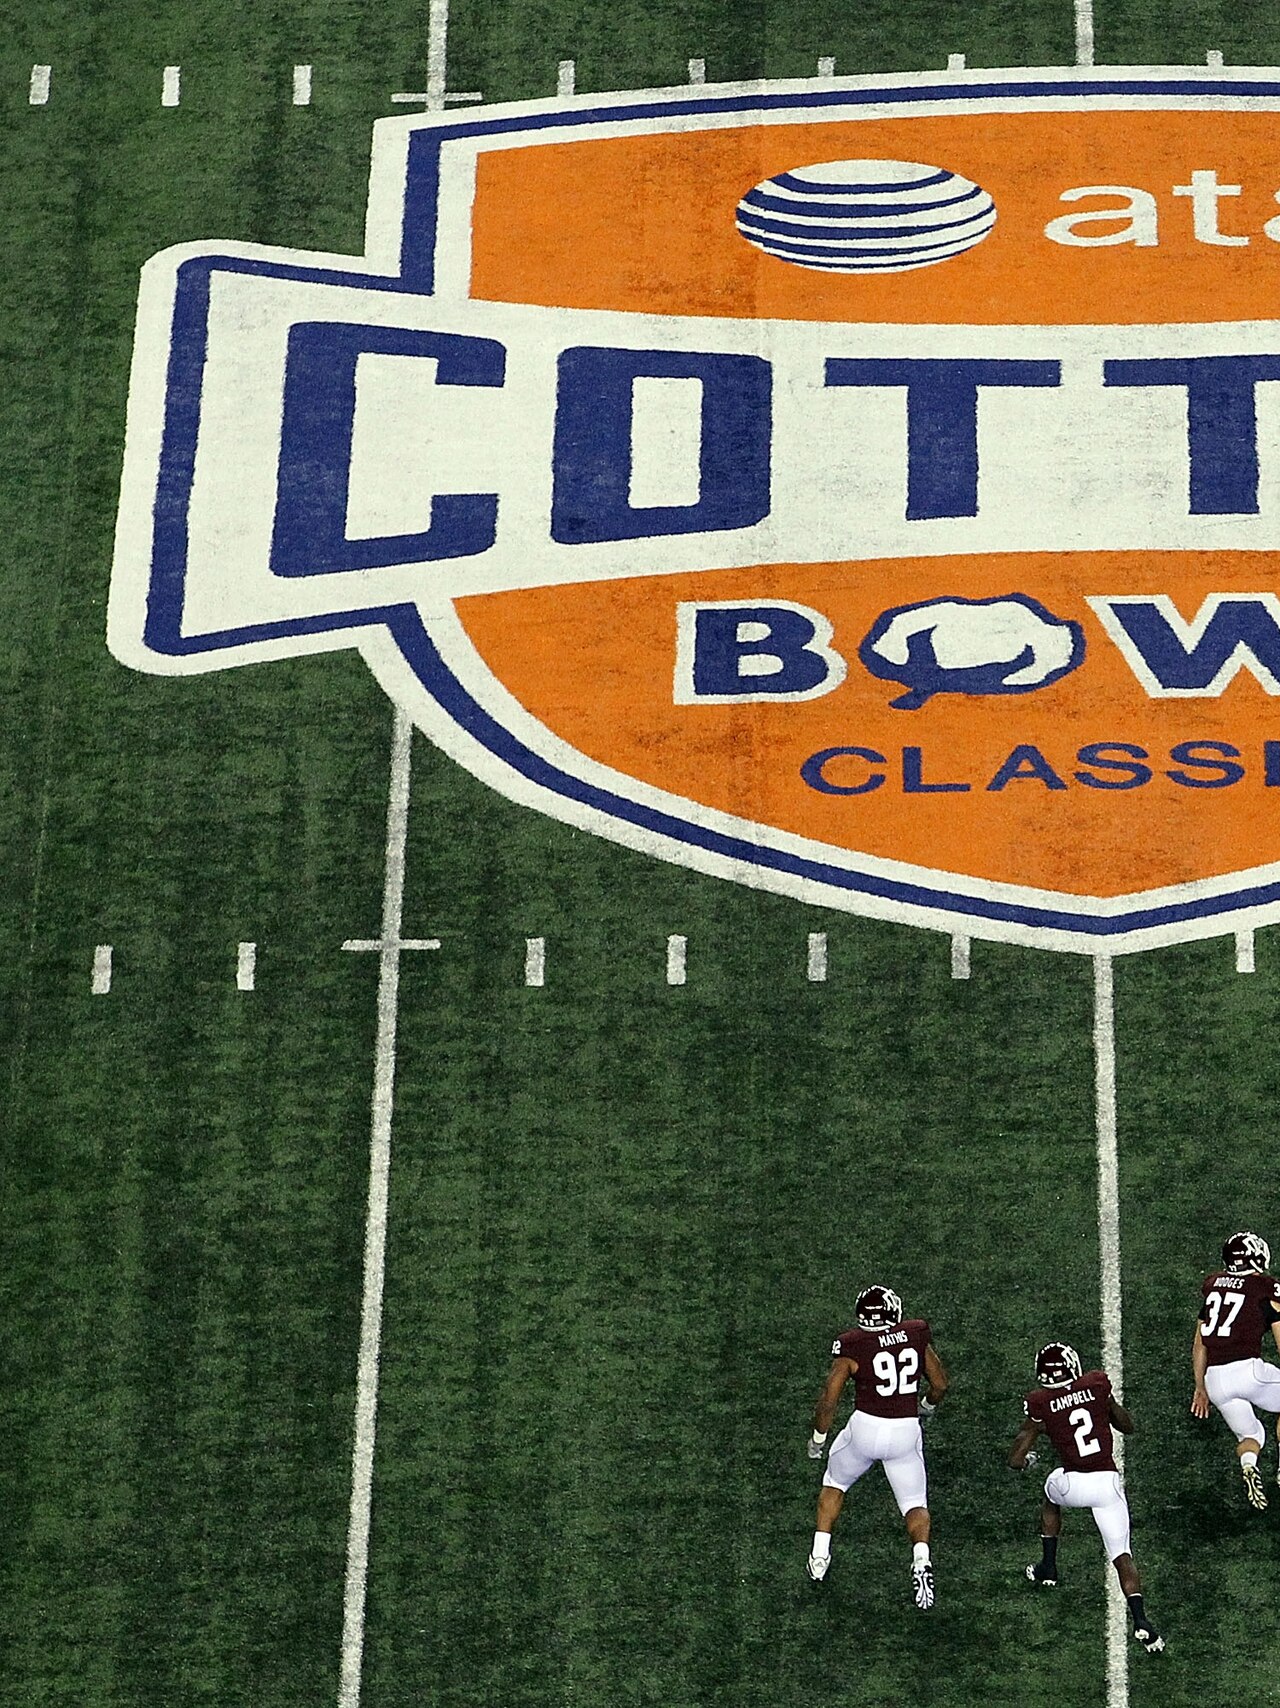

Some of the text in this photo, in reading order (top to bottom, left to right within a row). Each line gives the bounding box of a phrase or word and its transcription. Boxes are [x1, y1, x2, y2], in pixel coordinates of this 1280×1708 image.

[1200, 1291, 1246, 1337] 37
[878, 1330, 908, 1348] MATHIS
[872, 1347, 919, 1397] 92
[1049, 1388, 1096, 1413] CAMPBELL
[1068, 1407, 1101, 1458] 2
